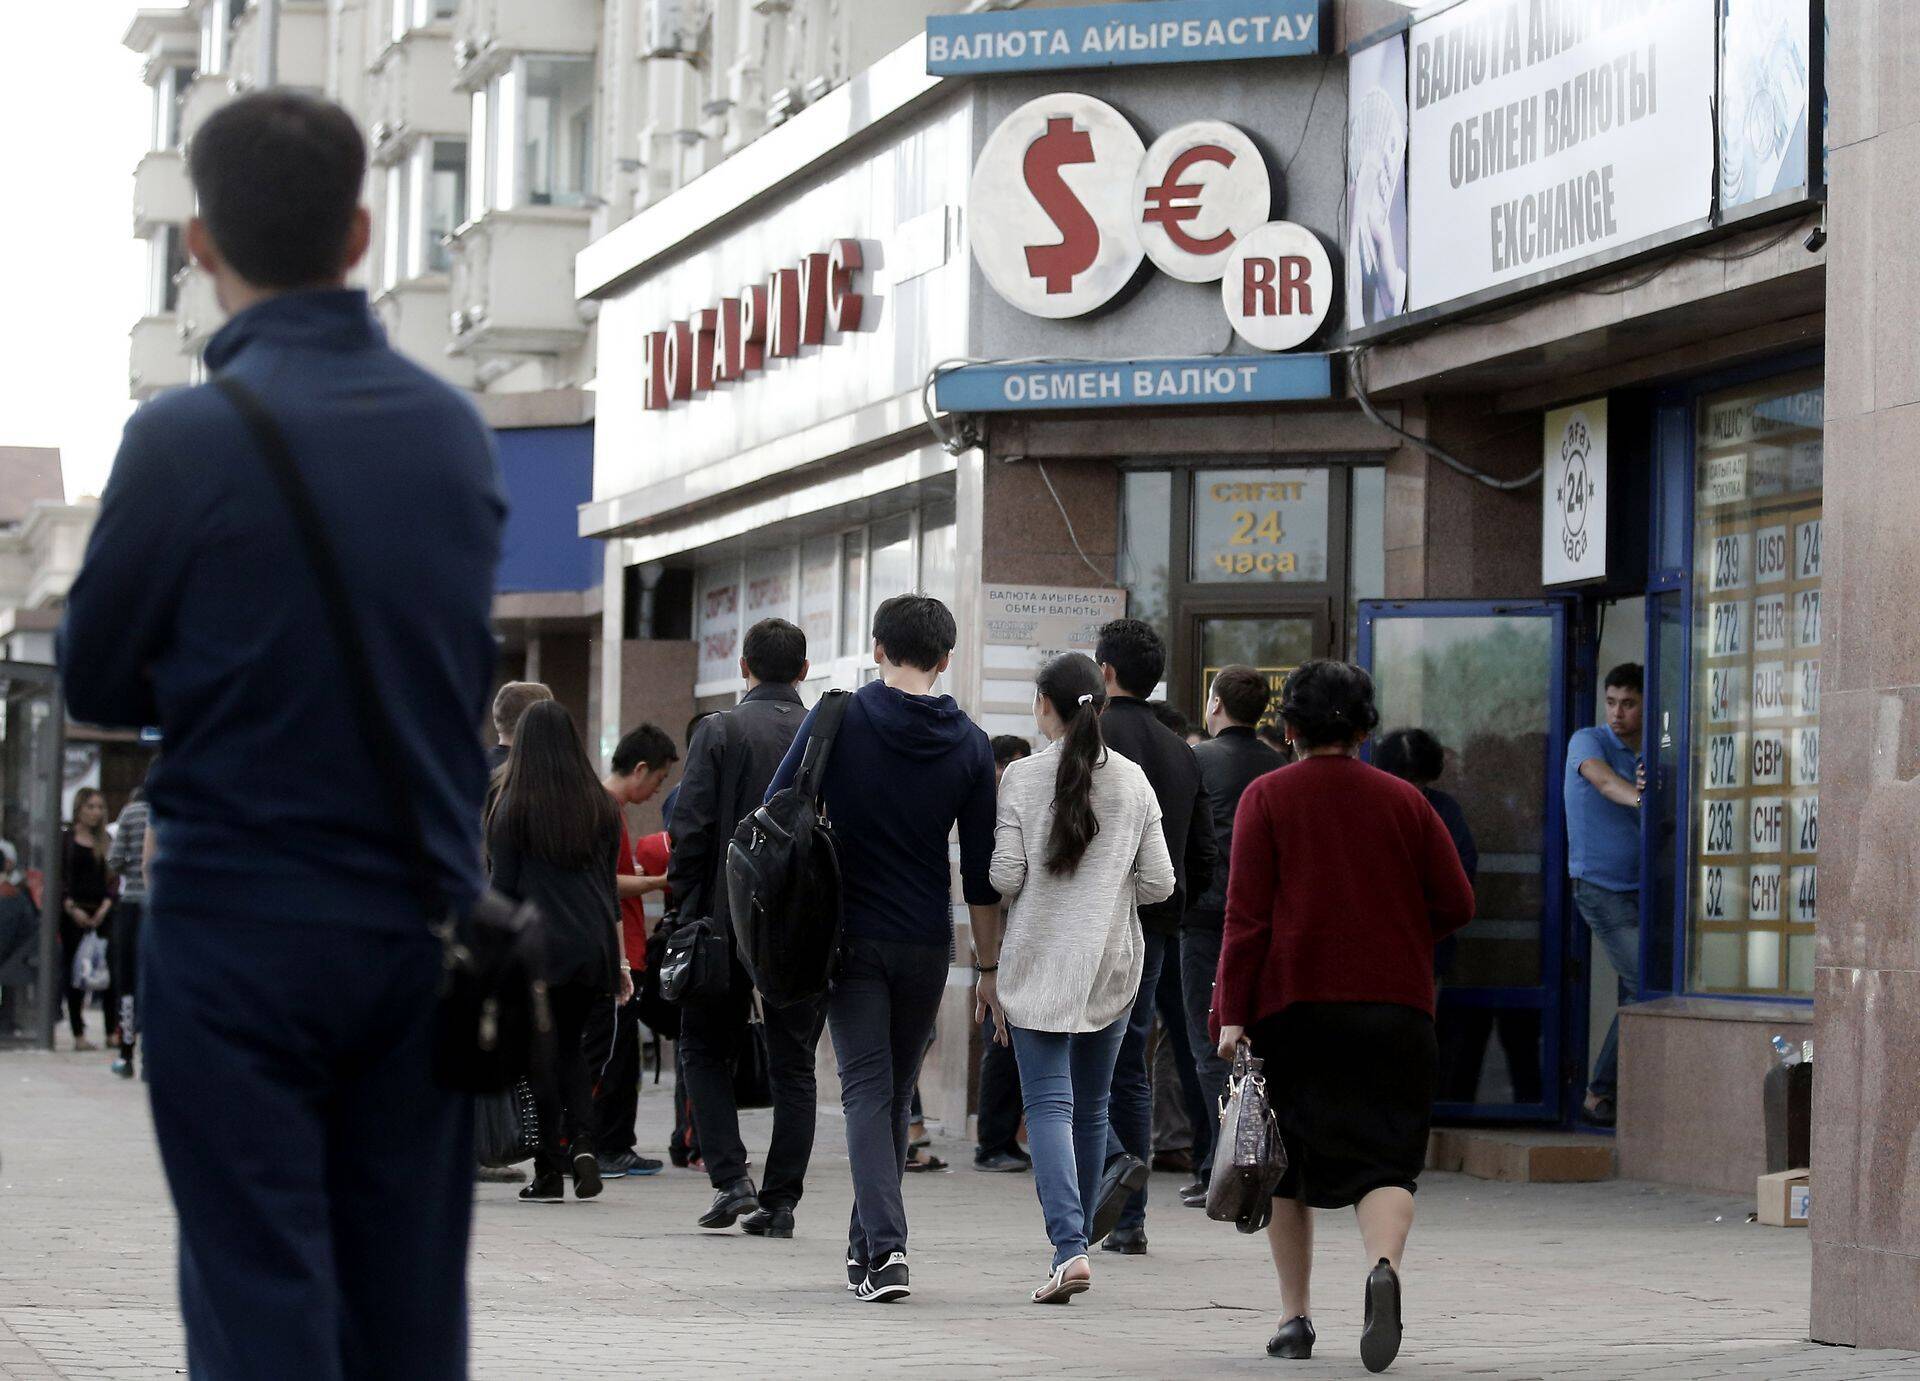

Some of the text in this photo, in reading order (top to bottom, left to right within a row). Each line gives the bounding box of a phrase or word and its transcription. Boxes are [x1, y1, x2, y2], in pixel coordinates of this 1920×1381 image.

[929, 14, 1314, 62] ВАЛЮТА АЙЫРБАСТАУ
[1416, 2, 1520, 110] ВАЛЮТА
[1449, 44, 1657, 190] ОБМЕН ВАЛЮТЫ
[1491, 164, 1618, 273] EXCHANGE
[1243, 255, 1313, 317] RR
[643, 238, 864, 410] НОТАРИУС
[1004, 366, 1258, 402] ОБМЕН ВАЛЮТ
[1567, 470, 1585, 514] 24
[1229, 510, 1284, 546] 24
[1562, 527, 1588, 562] часа
[1215, 550, 1297, 574] часа
[1715, 522, 1822, 588] 239 USD 24
[990, 590, 1118, 604] ВАЛЮТА АЙЫРБАСТАУ
[1005, 603, 1101, 617] ОБМЕН ВАЛЮТЫ
[1714, 602, 1739, 654] 272
[1756, 601, 1784, 641] EUR
[1755, 668, 1784, 709] RUR
[1710, 735, 1736, 786] 372
[1753, 738, 1782, 776] GBP
[1707, 802, 1733, 852] 236
[1754, 806, 1782, 843] CHF
[1706, 868, 1724, 917] 32
[1751, 874, 1781, 912] CHY
